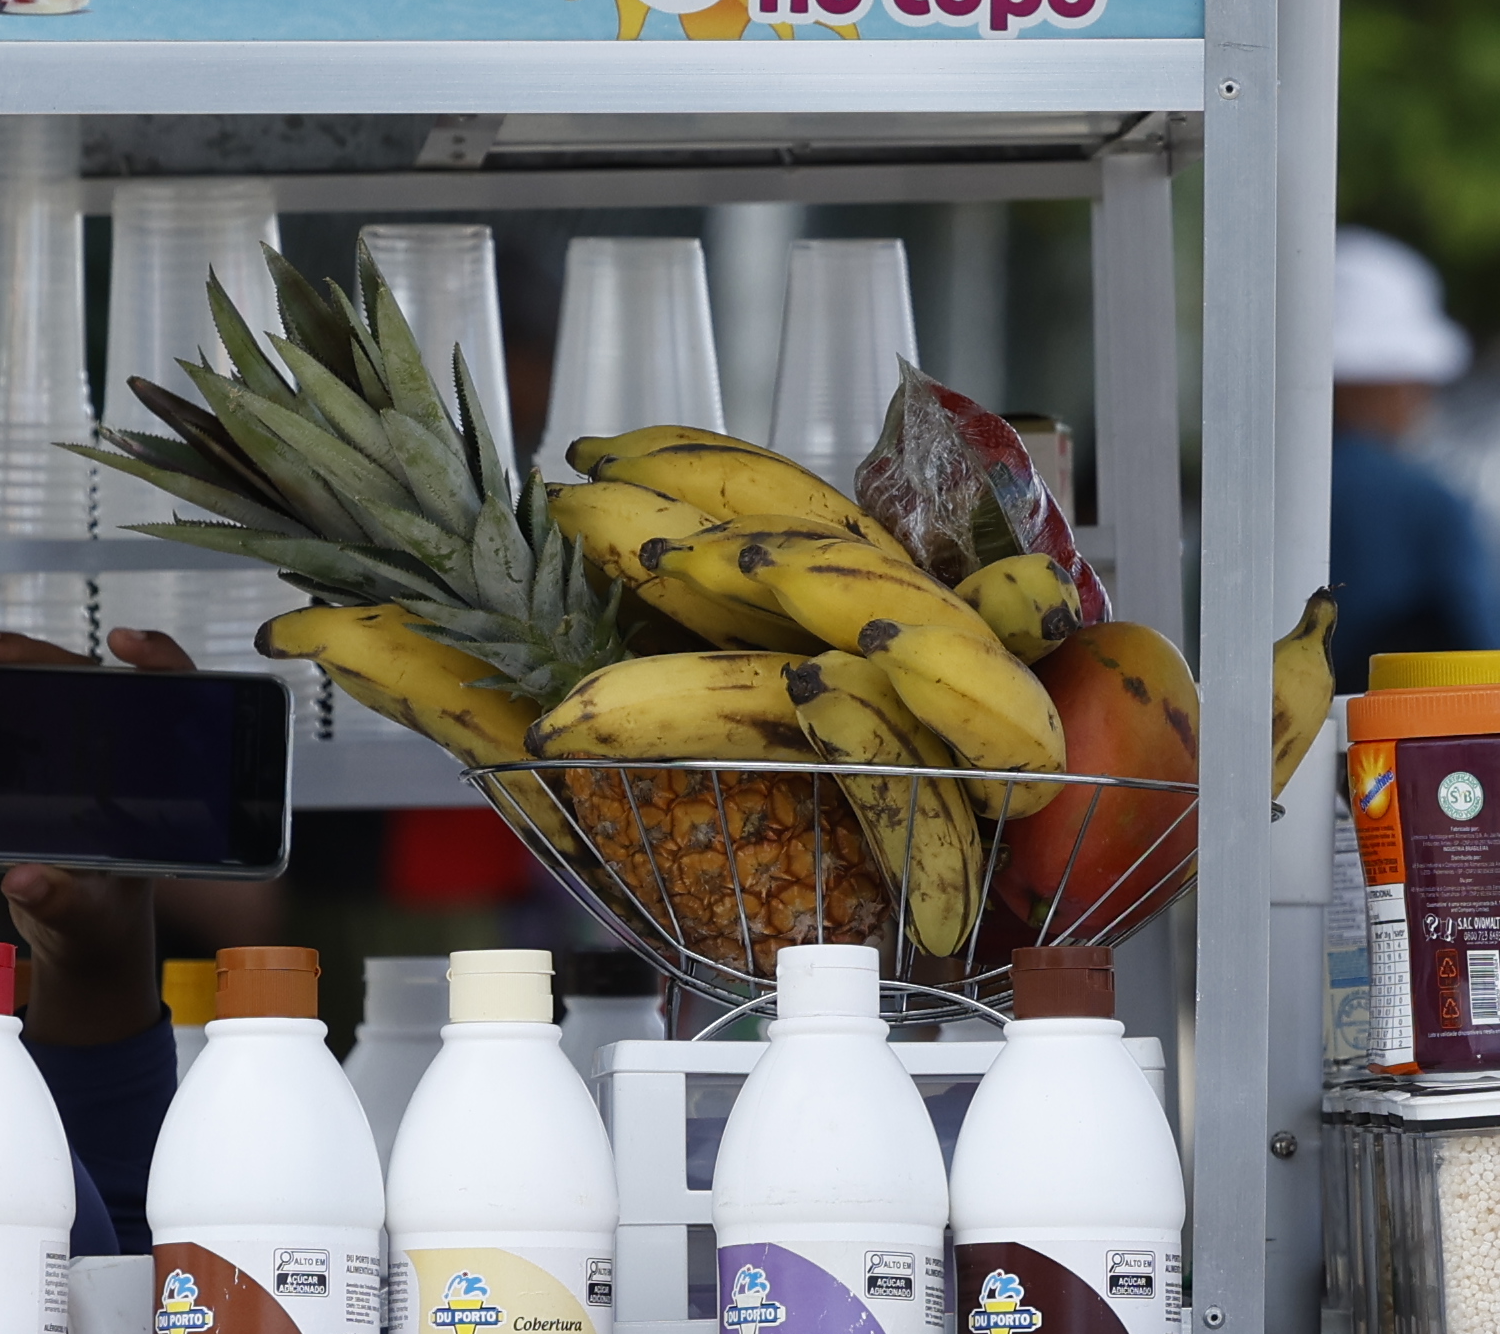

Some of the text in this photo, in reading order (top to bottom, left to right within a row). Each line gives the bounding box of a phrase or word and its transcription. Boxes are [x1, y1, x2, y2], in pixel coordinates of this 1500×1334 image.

[294, 1258, 326, 1266] ALTO EM
[883, 1260, 912, 1269] ALTO EM
[1124, 1259, 1152, 1268] ALTO EM
[287, 1273, 318, 1285] AÇÚCAR
[877, 1276, 906, 1289] AÇÚCAR
[1118, 1274, 1146, 1287] AÇÚCAR
[279, 1284, 325, 1294] ADICIONADO
[870, 1286, 911, 1297] ADICIONADO
[1111, 1285, 1151, 1296] ADICIONADO
[158, 1313, 201, 1327] DU PORTO
[437, 1310, 496, 1323] DU PORTO
[728, 1308, 775, 1322] DU PORTO
[975, 1313, 1030, 1327] DU PORTO
[513, 1316, 582, 1332] Cobertura
